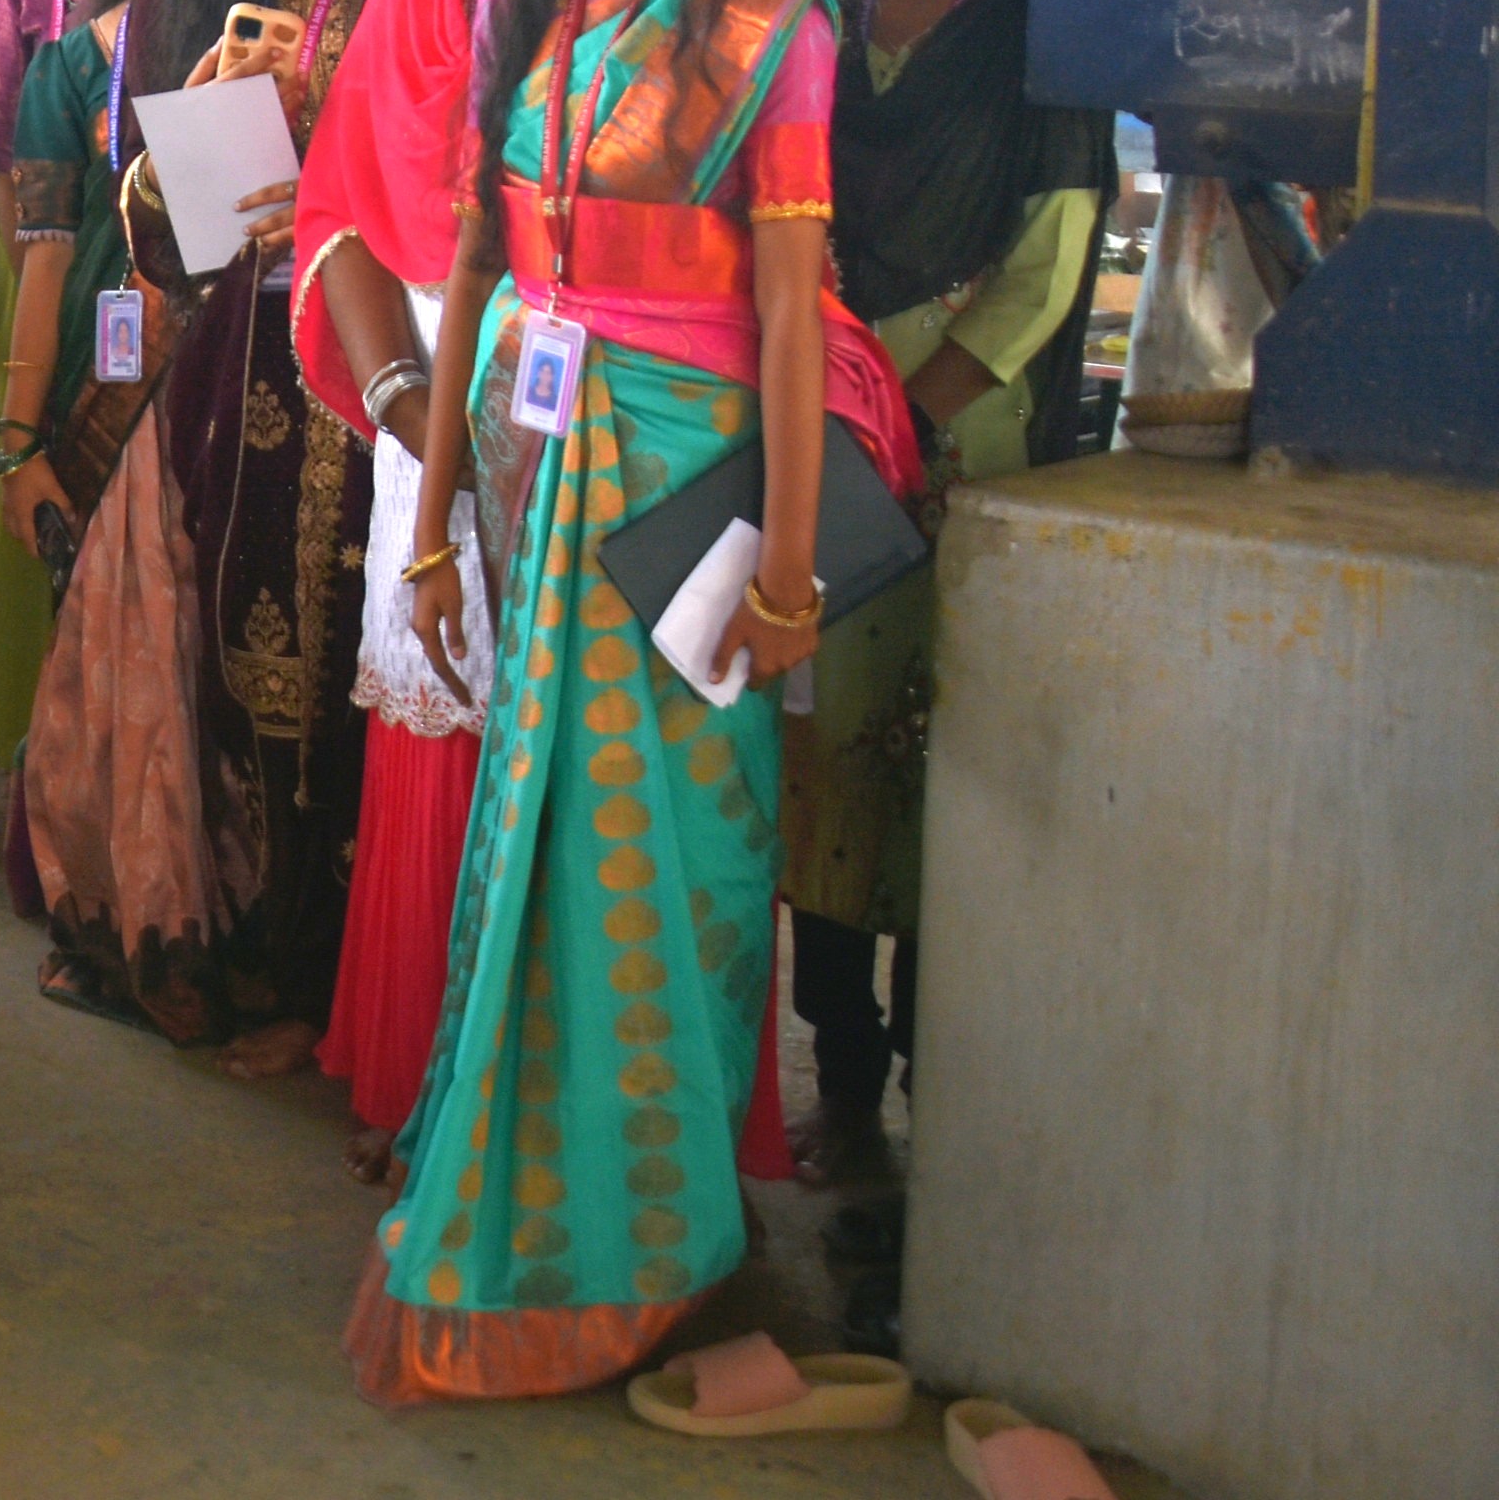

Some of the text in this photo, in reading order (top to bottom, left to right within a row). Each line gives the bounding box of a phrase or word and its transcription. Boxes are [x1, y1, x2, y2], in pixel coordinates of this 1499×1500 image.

[306, 25, 318, 48] ARTS
[312, 4, 325, 24] AND
[114, 45, 125, 79] COLLEGE
[111, 80, 121, 117] SCIENCE
[110, 118, 118, 140] AND
